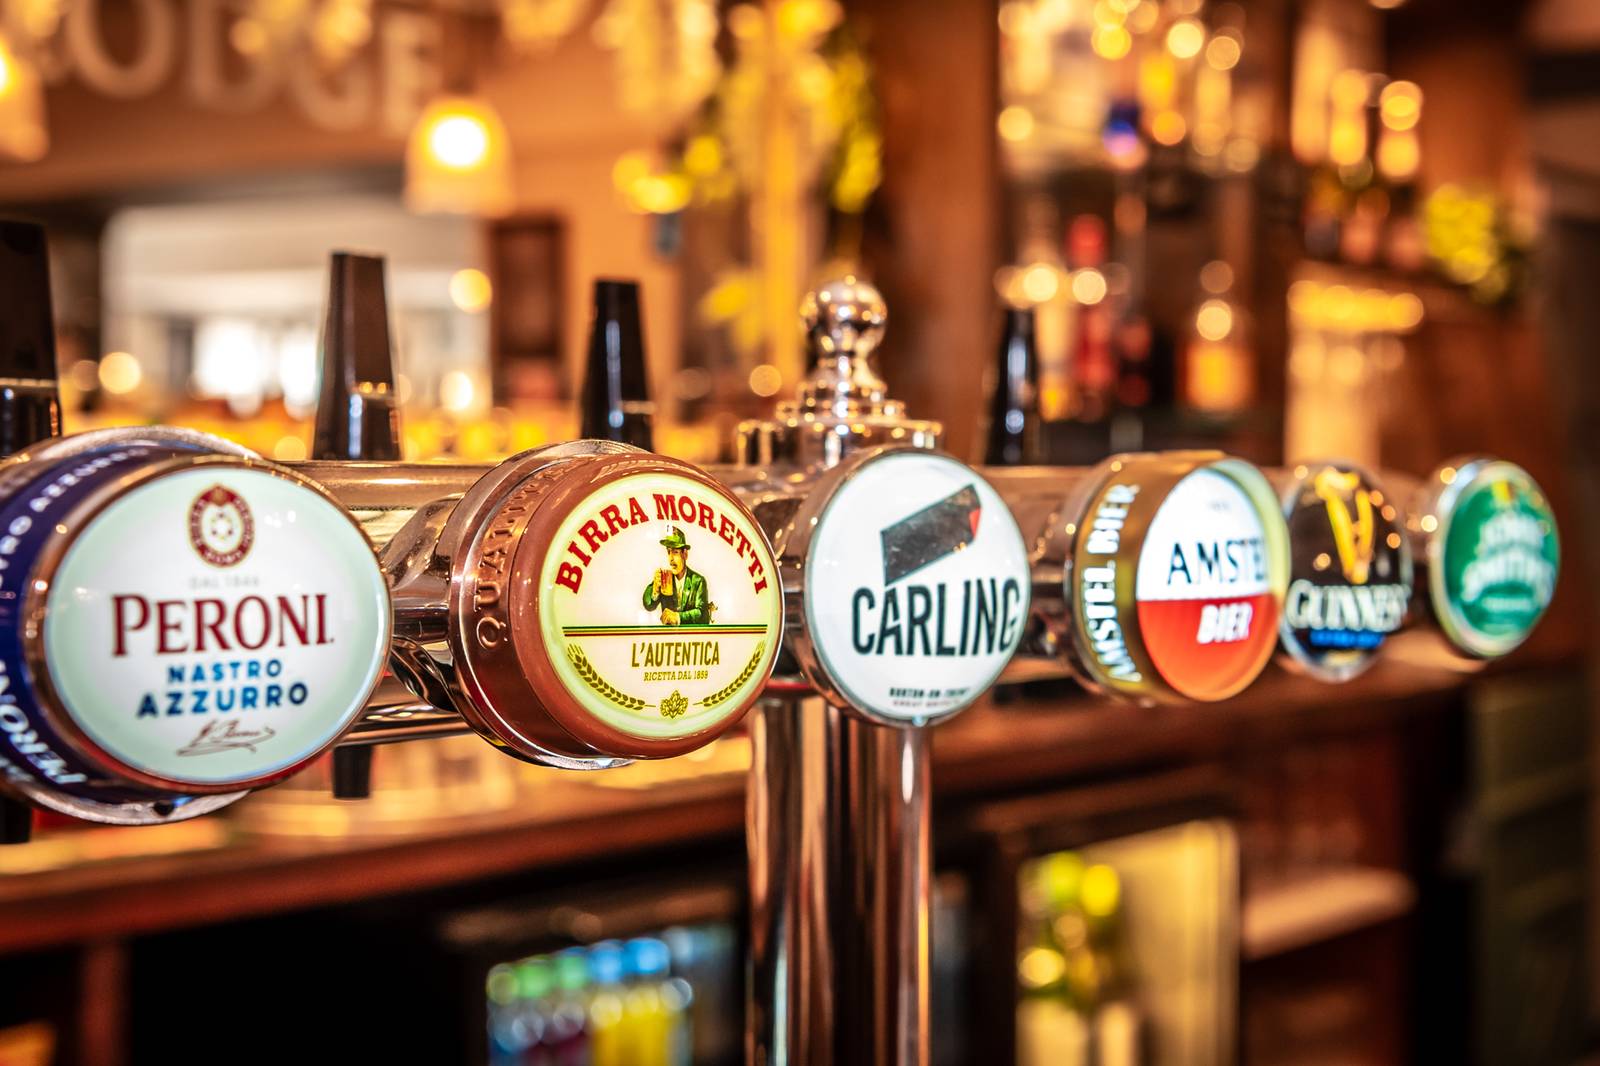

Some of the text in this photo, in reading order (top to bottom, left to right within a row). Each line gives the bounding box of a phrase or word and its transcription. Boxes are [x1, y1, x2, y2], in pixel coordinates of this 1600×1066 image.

[555, 492, 769, 595] BIRRA MORETTI
[1083, 484, 1143, 683] AMSTEL BIER
[111, 593, 328, 657] PERONI
[852, 577, 1021, 657] CARLING
[1196, 602, 1254, 645] BIER
[167, 659, 283, 684] NASTRO
[643, 670, 709, 681] RICETTA DAL 1859
[136, 681, 309, 719] AZZURRO
